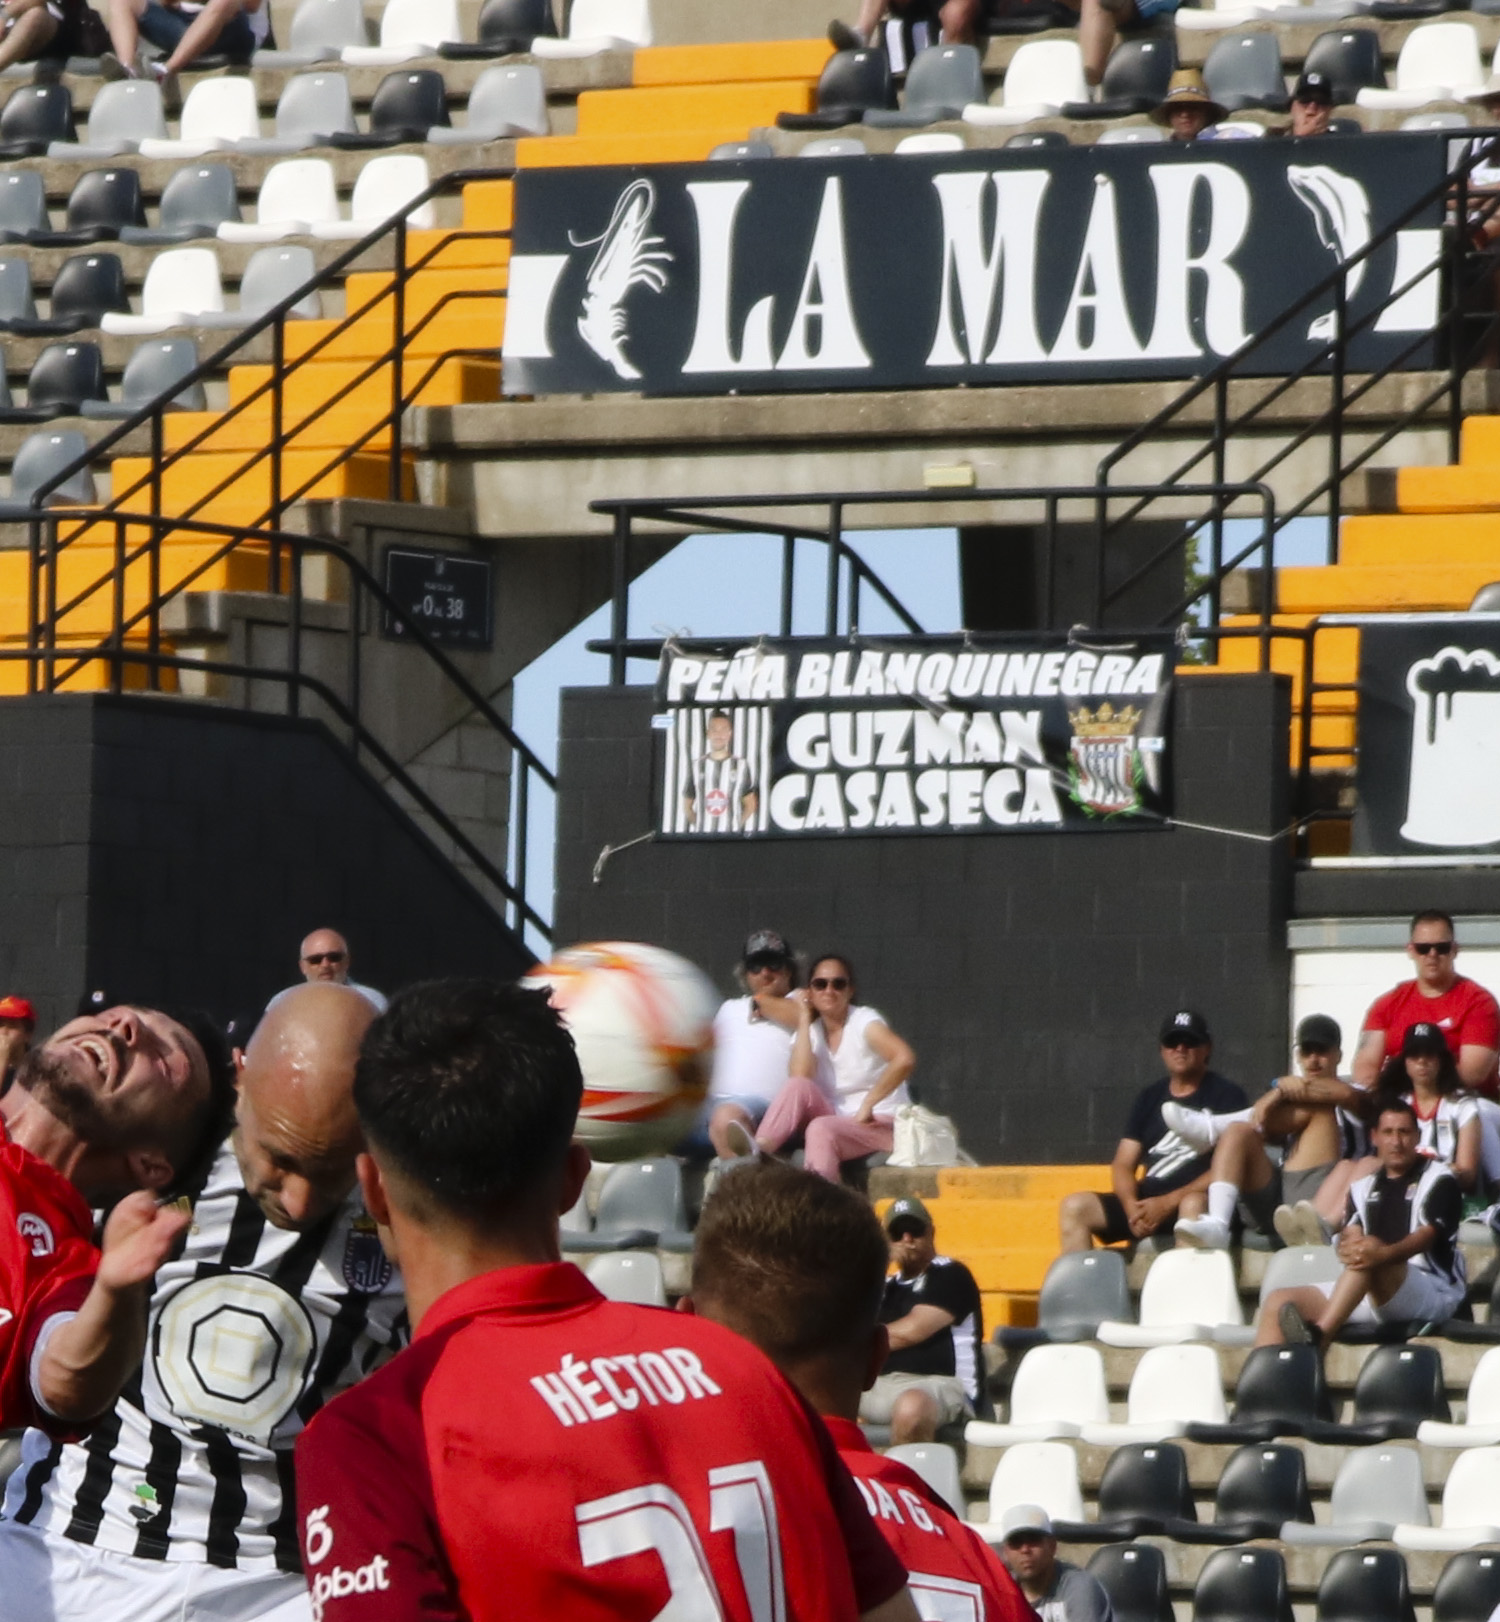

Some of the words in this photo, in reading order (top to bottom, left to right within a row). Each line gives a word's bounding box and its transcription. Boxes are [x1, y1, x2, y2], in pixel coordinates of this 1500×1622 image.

[682, 175, 871, 372] LA
[925, 162, 1256, 368] MAR
[666, 648, 786, 701] PEÑA
[795, 650, 1166, 701] BLANQUINEGRA
[786, 709, 1045, 770] GUZMAN
[769, 768, 1063, 829] CASASECA
[530, 1347, 721, 1427] HÉCTOR
